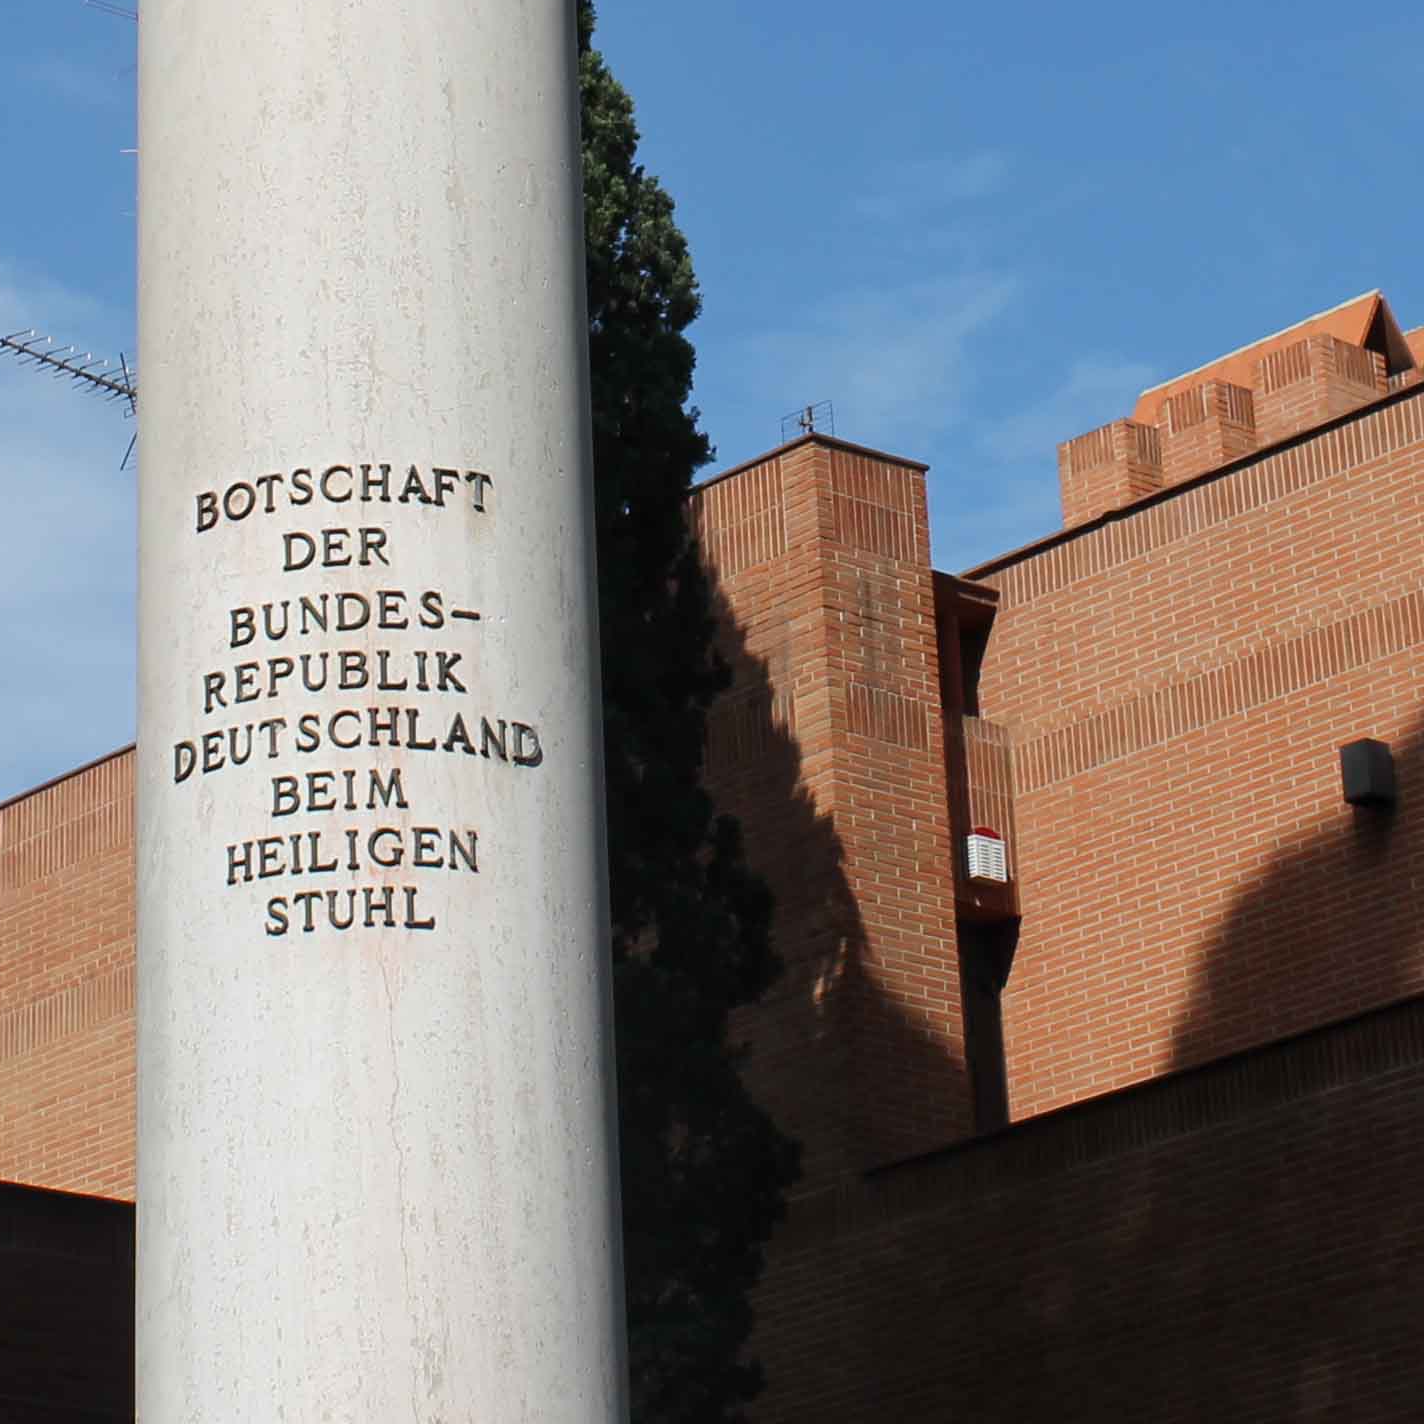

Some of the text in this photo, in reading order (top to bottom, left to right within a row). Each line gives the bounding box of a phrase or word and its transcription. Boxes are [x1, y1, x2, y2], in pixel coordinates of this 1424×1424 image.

[195, 463, 494, 534] BOTSCHAFT
[282, 527, 390, 573] DER
[229, 590, 481, 649] BUNDES-
[203, 650, 467, 715] REPUBLIK
[173, 706, 544, 785] DEUTSCHLAND
[271, 767, 409, 818] BEIM
[226, 827, 480, 887] HEILIGEN
[264, 886, 436, 937] STUHL
